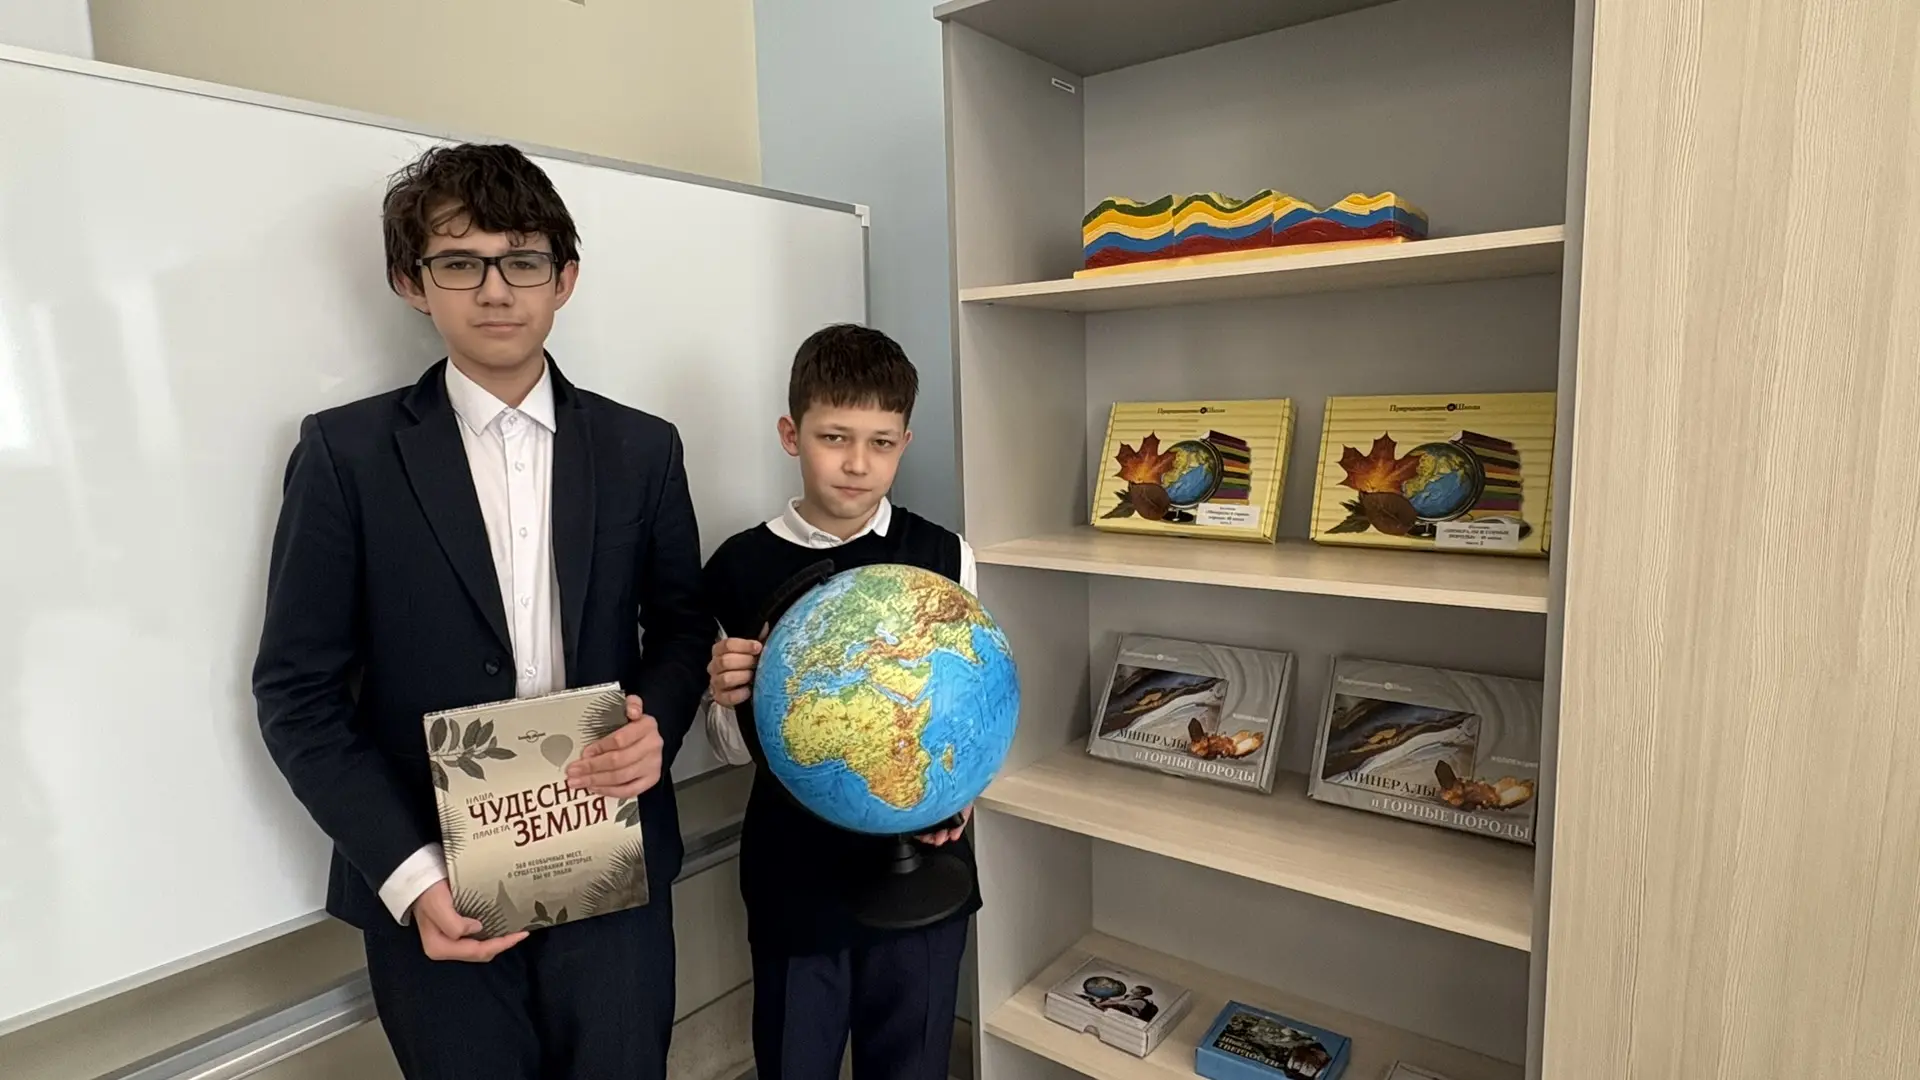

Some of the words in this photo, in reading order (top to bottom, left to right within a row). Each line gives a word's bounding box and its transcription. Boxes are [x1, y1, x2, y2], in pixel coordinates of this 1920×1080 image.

[1119, 728, 1187, 750] МИНЕРАЛЫ
[1143, 751, 1196, 770] ГОРНЫЕ
[1197, 761, 1256, 783] ПОРОДЫ
[466, 792, 494, 805] НАША
[1345, 771, 1437, 797] МИНЕРАЛЫ
[468, 779, 596, 826] ЧУДЕСНА
[472, 824, 511, 840] ПЛАНЕТА
[513, 795, 608, 847] ЗЕМЛЯ
[1382, 797, 1450, 822] ГОРНЫЕ
[1453, 812, 1530, 840] ПОРОДЫ
